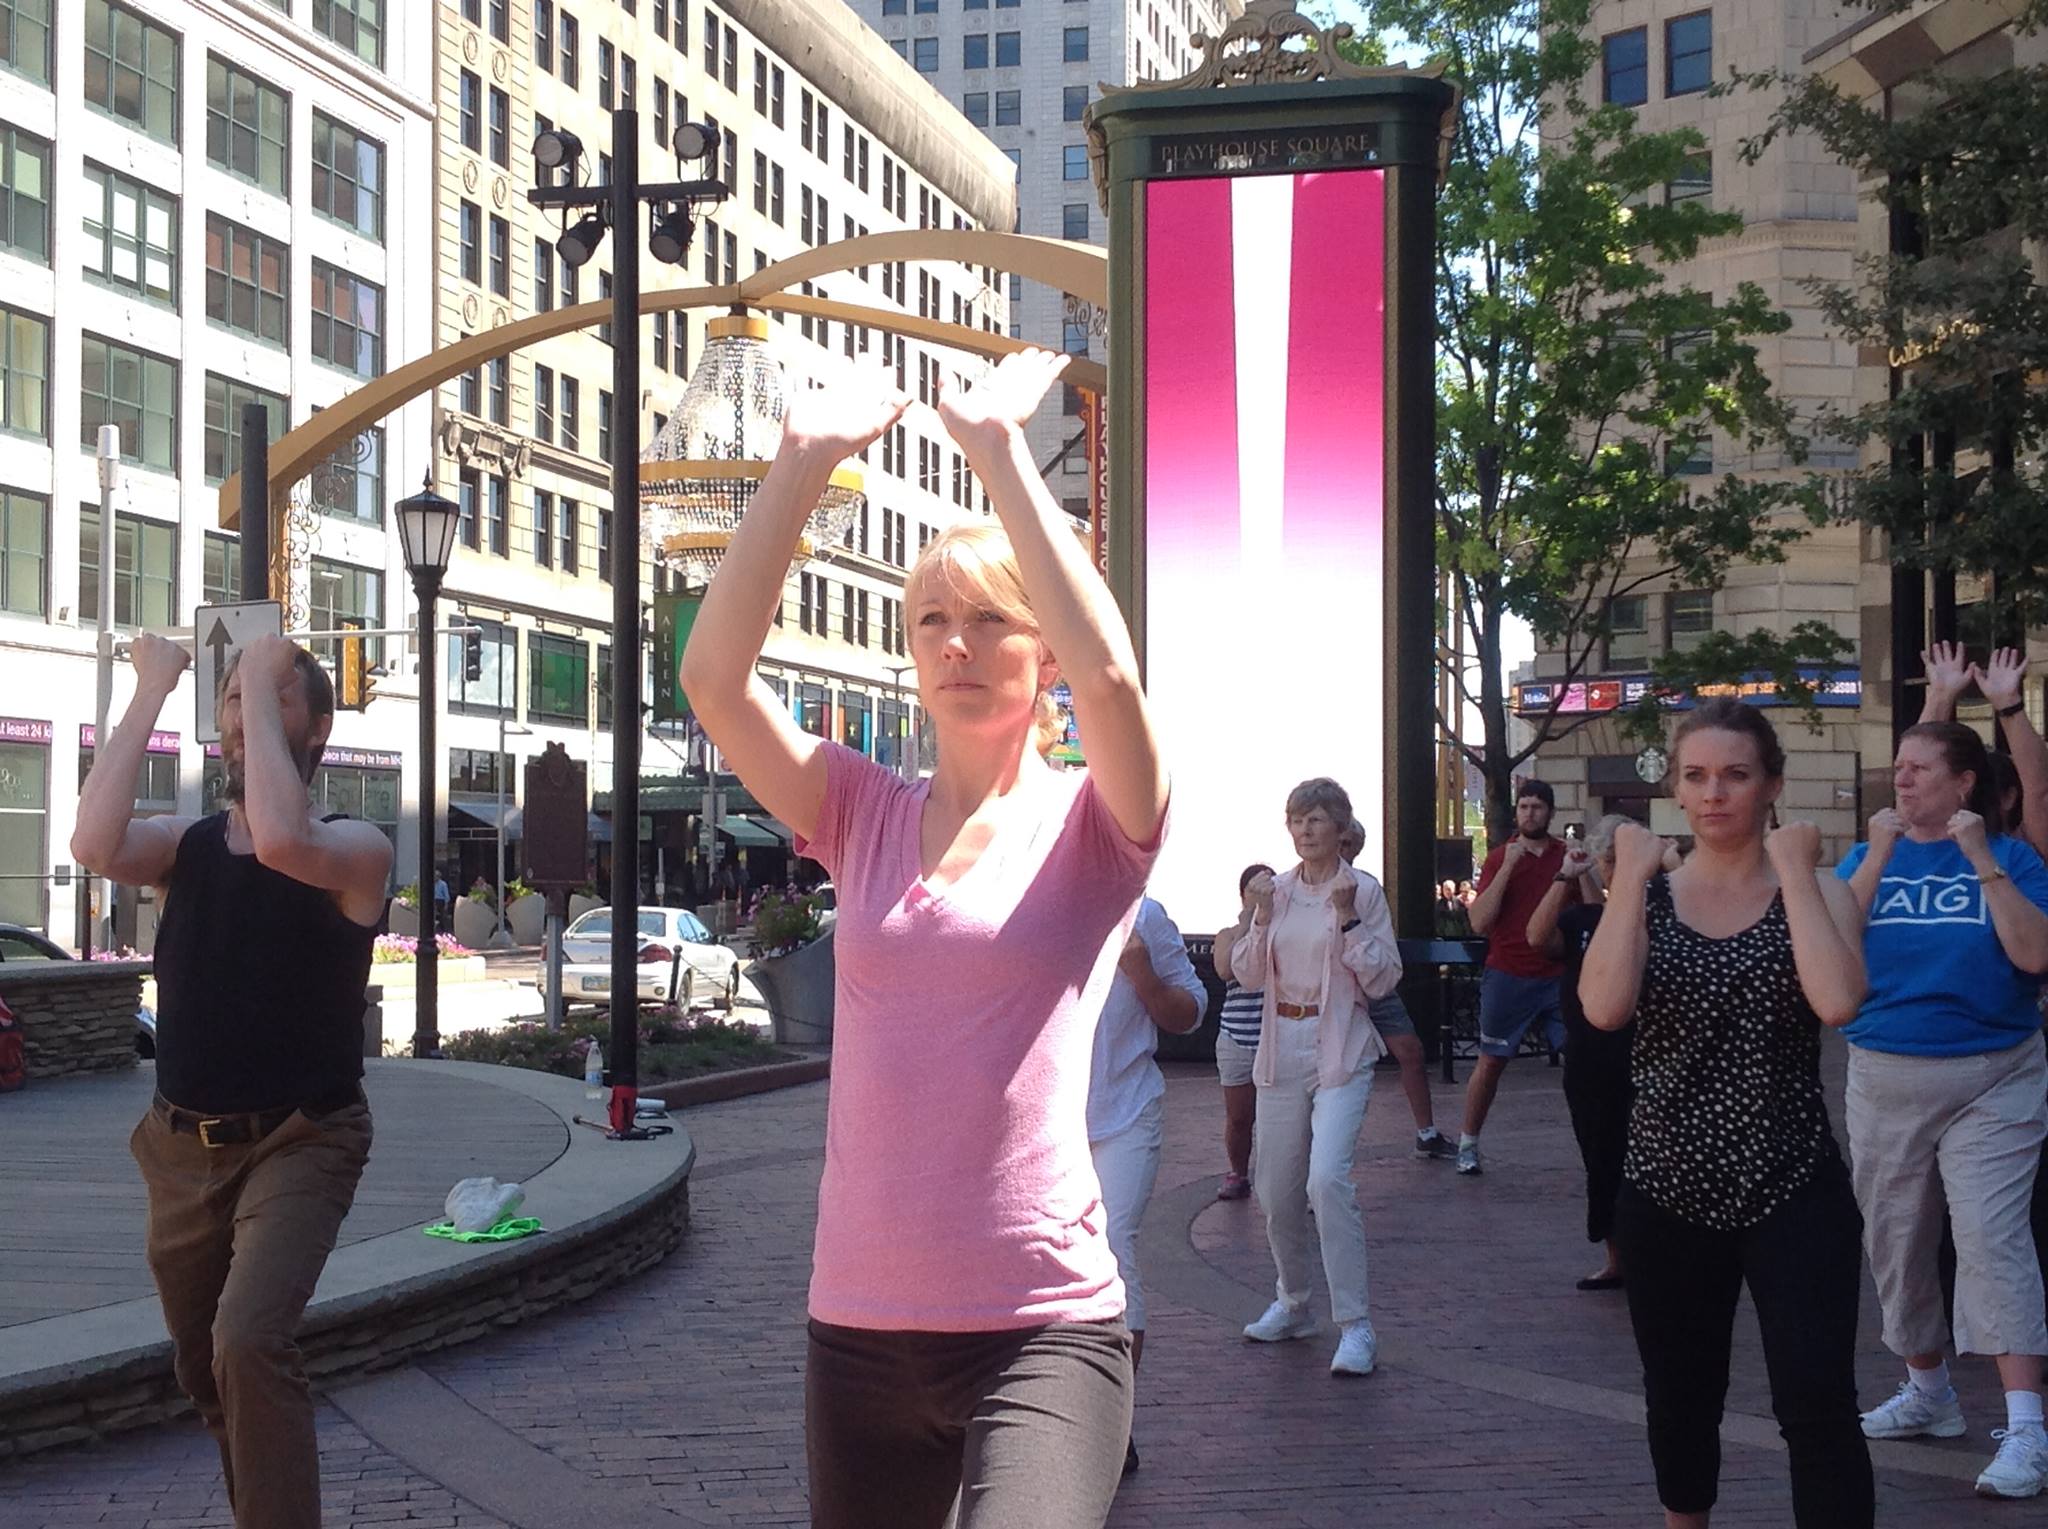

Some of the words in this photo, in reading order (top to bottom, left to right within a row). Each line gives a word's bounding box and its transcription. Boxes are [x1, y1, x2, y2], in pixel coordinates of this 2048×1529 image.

[1161, 139, 1279, 161] PLAYHOUSE
[1287, 134, 1369, 155] SQUARE
[661, 615, 671, 698] ALLEN
[6, 722, 30, 737] least
[30, 725, 42, 738] 24
[353, 753, 366, 766] may
[375, 754, 390, 765] from
[1879, 884, 1970, 914] AIG
